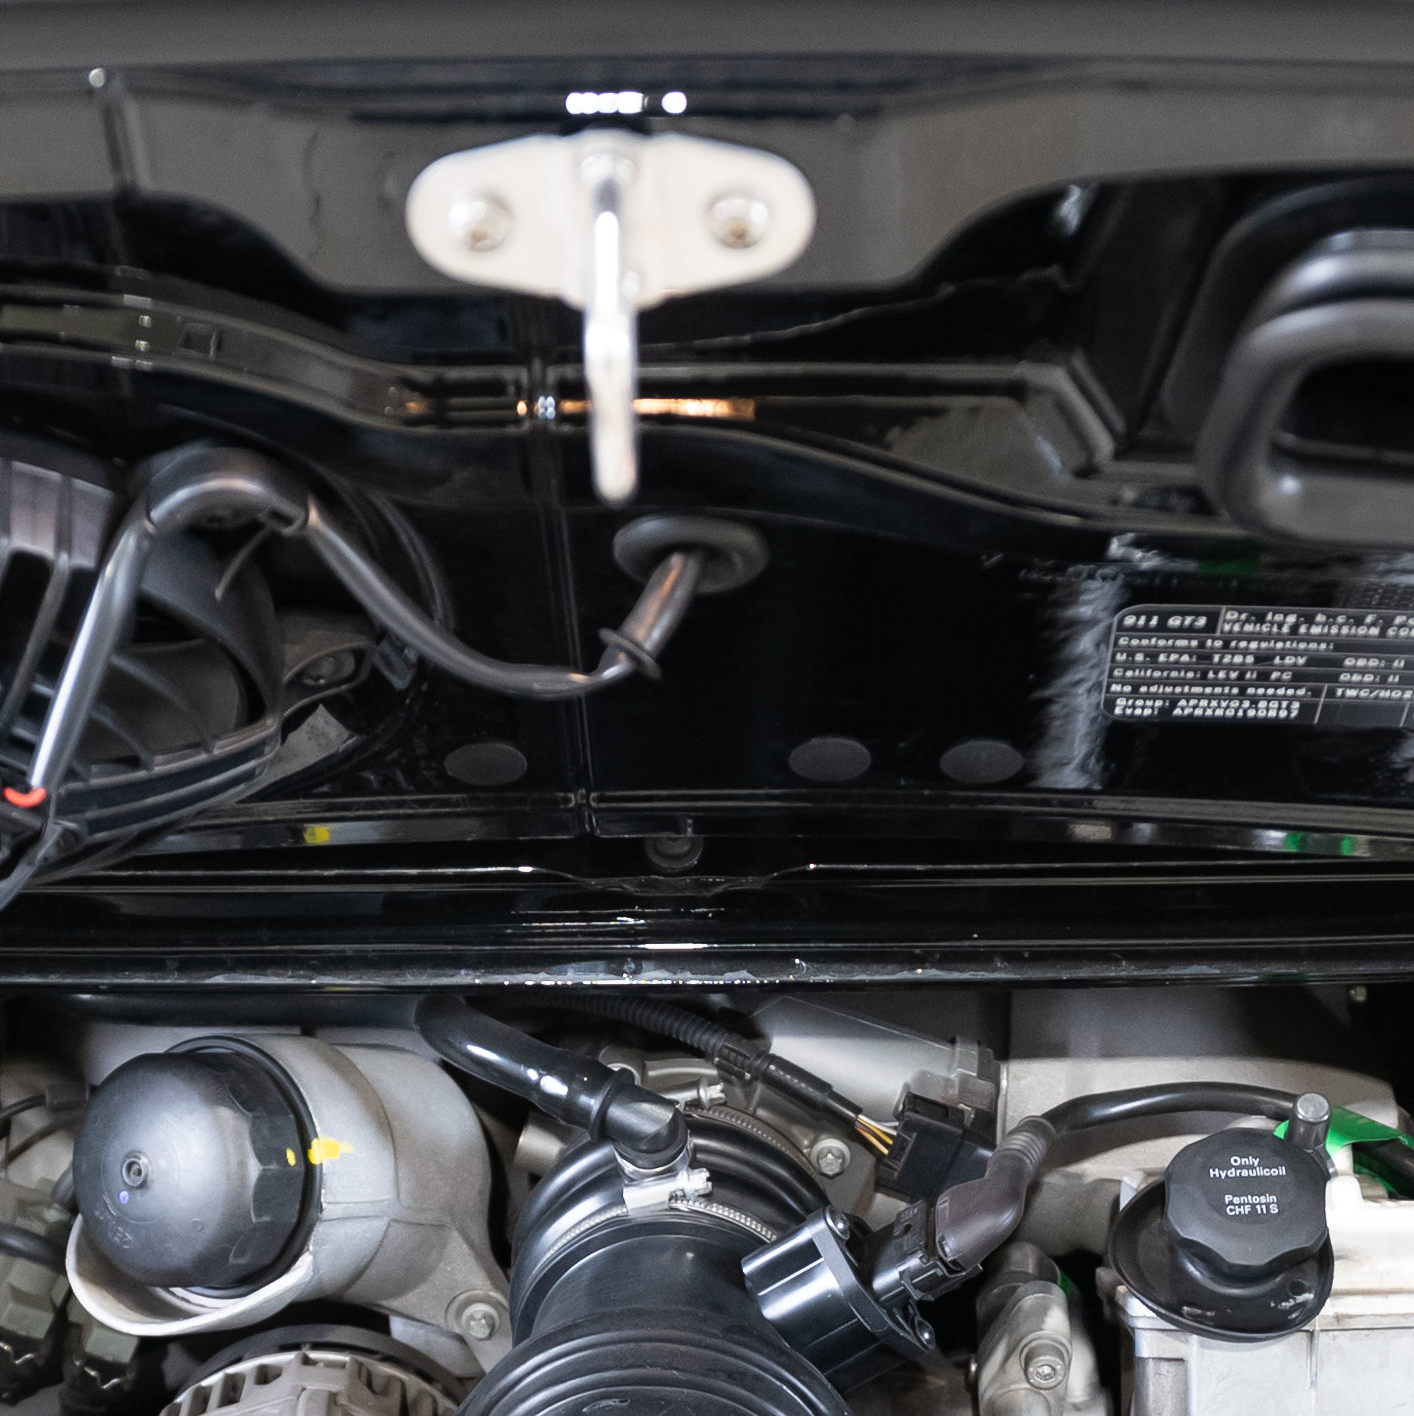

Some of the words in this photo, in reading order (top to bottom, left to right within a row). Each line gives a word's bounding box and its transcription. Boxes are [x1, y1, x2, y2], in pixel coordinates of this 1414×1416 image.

[1123, 615, 1159, 627] 911
[1167, 615, 1207, 628] GT3
[1225, 610, 1255, 620] Dr.
[1266, 611, 1305, 625] Ing.
[1364, 613, 1383, 626] F.
[1222, 622, 1291, 634] VEHICLE
[1298, 624, 1380, 637] EMISSION
[1118, 637, 1198, 648] Conforms
[1206, 639, 1224, 648] to
[1229, 640, 1334, 652] regulations:
[1158, 653, 1197, 664] EPA:
[1273, 655, 1307, 666] LDV
[1343, 657, 1386, 668] OBD:
[1113, 668, 1202, 679] California:
[1208, 669, 1239, 680] LEV
[1269, 671, 1293, 681] PC
[1339, 672, 1380, 683] OBD:
[1110, 683, 1132, 693] No
[1139, 684, 1240, 695] adjustments
[1246, 687, 1312, 698] needed.
[1115, 697, 1170, 708] Group:
[1114, 707, 1159, 717] Evap:
[1230, 1155, 1260, 1167] Only
[1209, 1166, 1287, 1180] Hydraulicoil
[1224, 1193, 1278, 1205] Pentosin
[1226, 1204, 1252, 1215] CHF
[1256, 1204, 1267, 1214] 11
[1269, 1203, 1279, 1214] S
